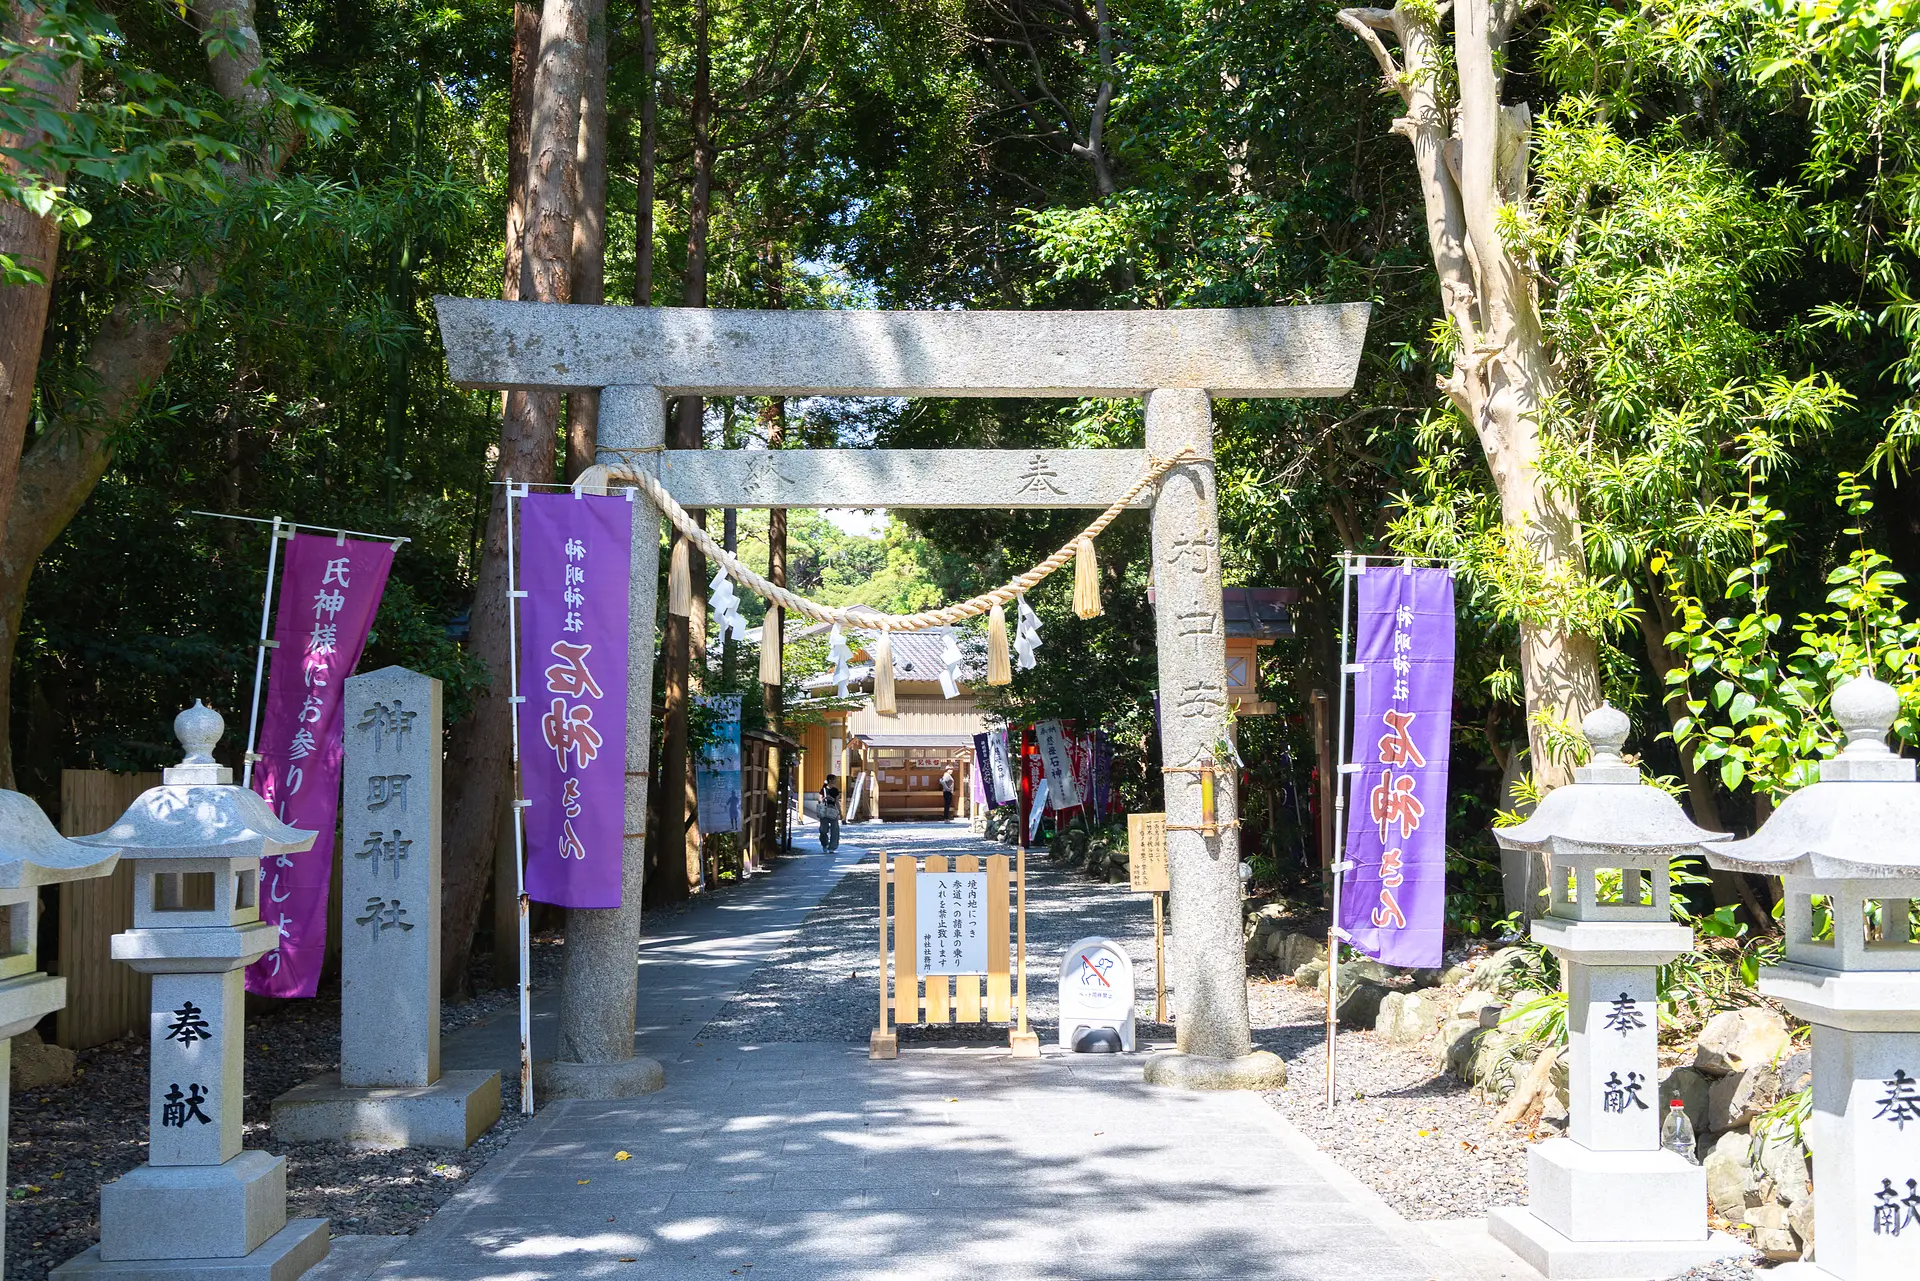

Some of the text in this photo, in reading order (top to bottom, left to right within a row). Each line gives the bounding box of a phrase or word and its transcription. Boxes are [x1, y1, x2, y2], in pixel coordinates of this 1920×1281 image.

[354, 699, 418, 942] 神明神社
[937, 880, 948, 968] 入れを禁止致します
[952, 879, 963, 967] 参道への諸車の乗り
[967, 879, 978, 938] 境内地につき
[162, 1000, 213, 1129] 奉献
[1602, 991, 1650, 1115] 奉献
[1872, 1068, 1920, 1238] 奉献
